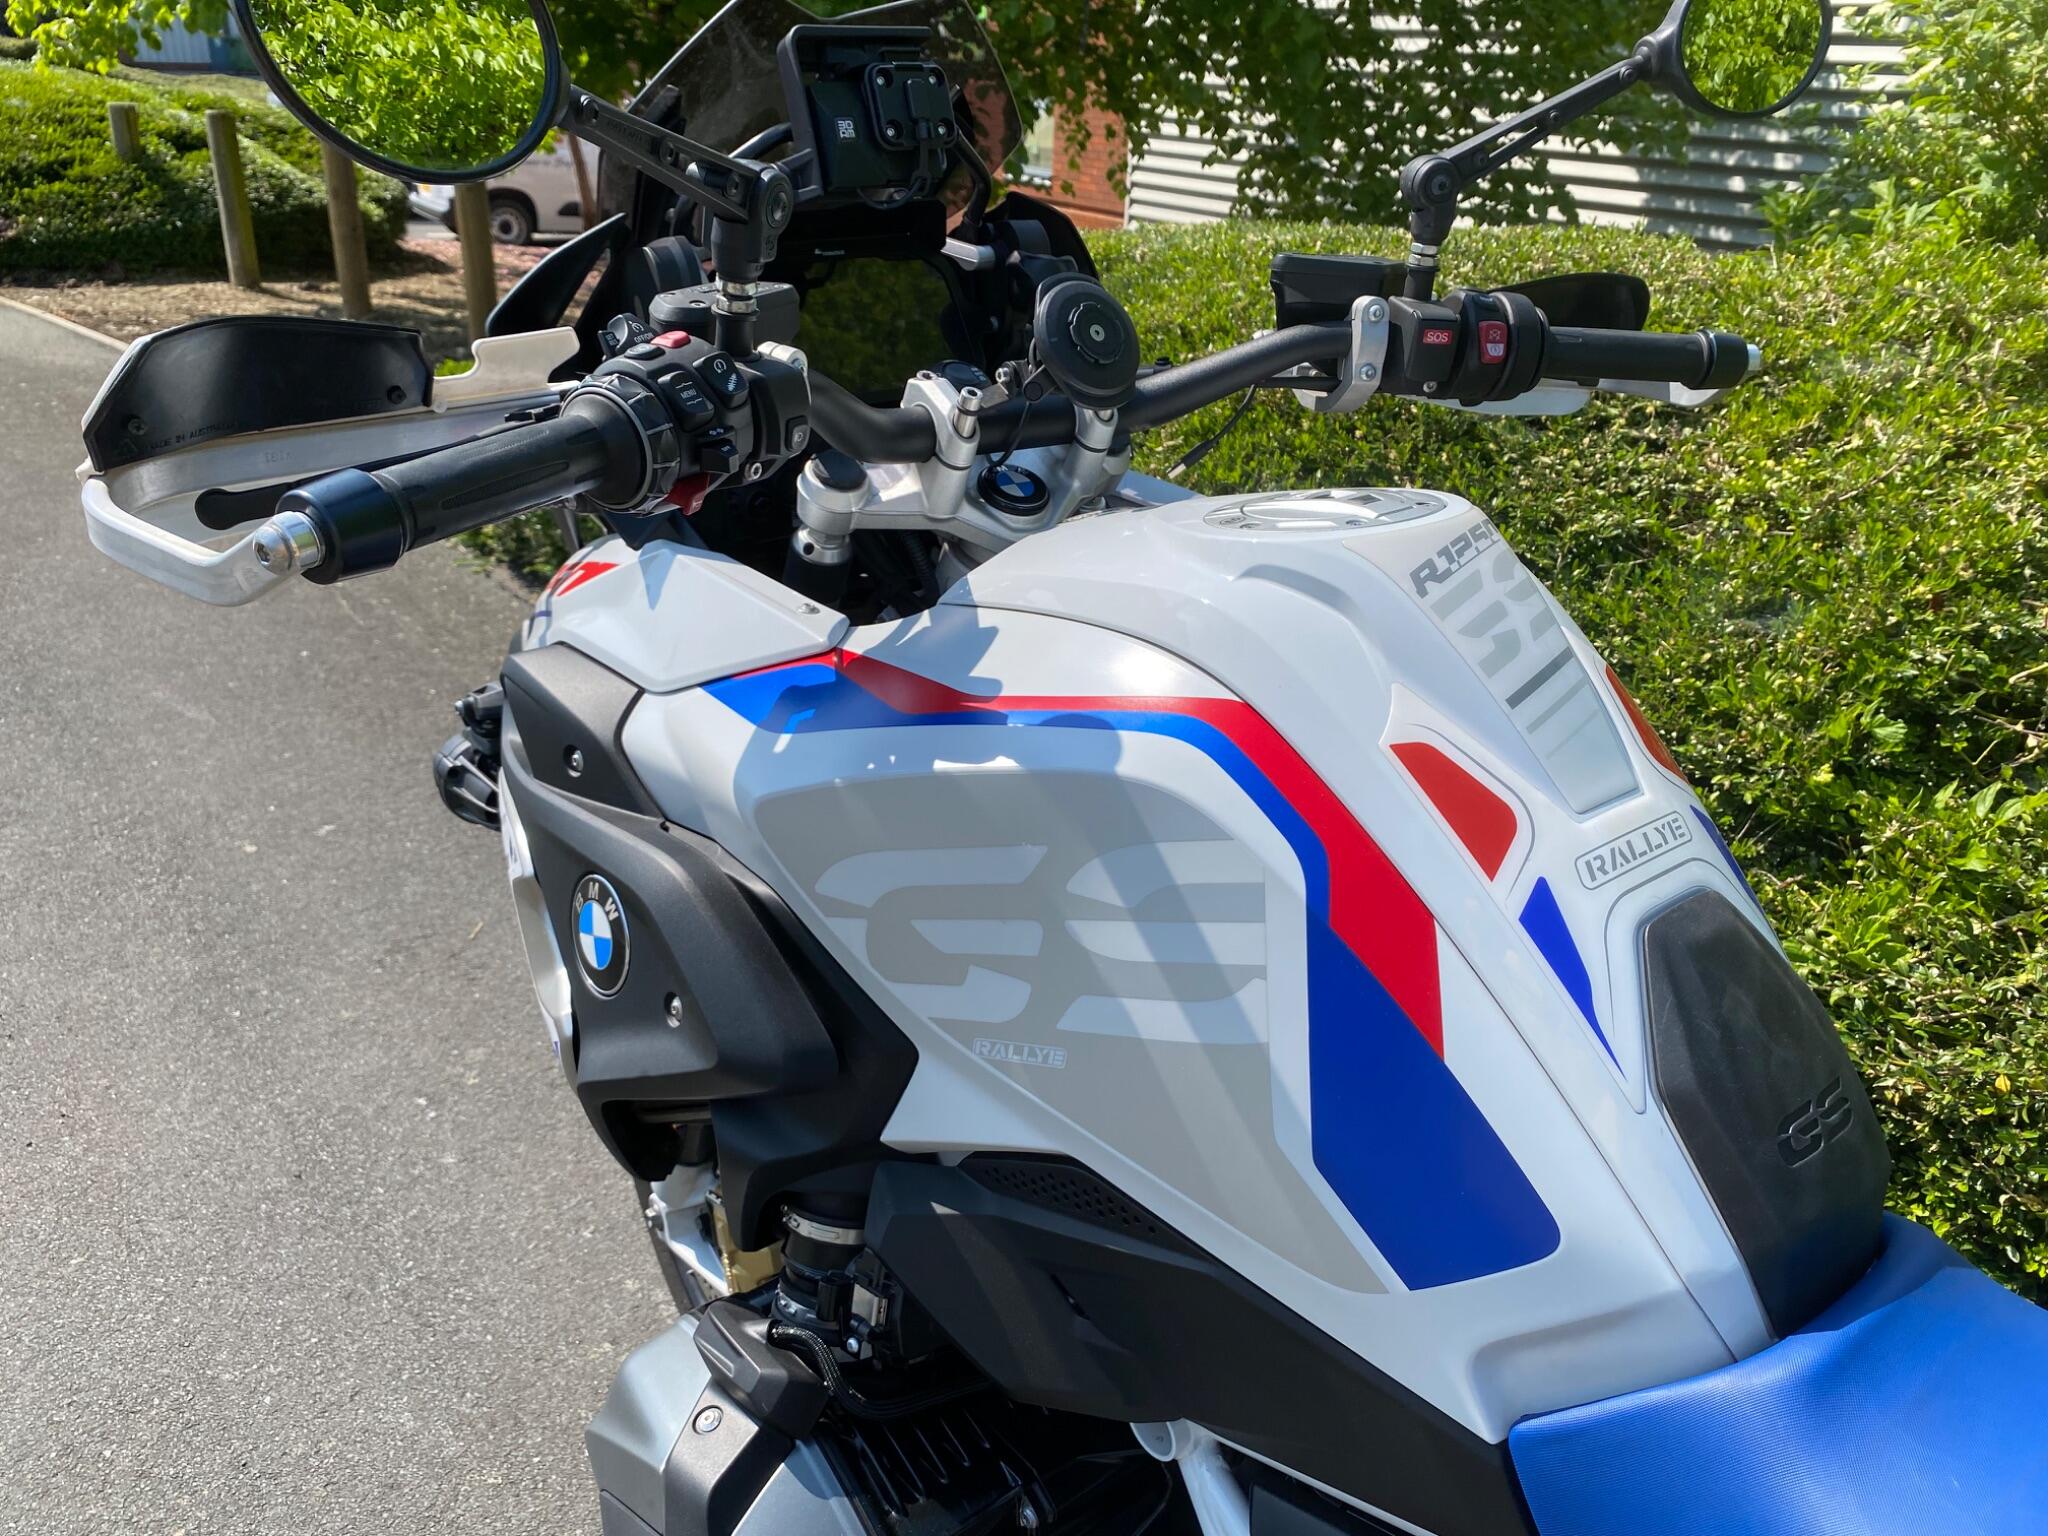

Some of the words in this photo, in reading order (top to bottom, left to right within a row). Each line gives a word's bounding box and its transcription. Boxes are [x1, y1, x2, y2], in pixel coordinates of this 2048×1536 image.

[1427, 331, 1449, 343] SOS
[680, 389, 697, 399] MENU
[1585, 817, 1686, 882] RALLYE
[575, 881, 620, 920] BMW
[975, 1041, 1064, 1064] RALLYE
[1777, 1076, 1853, 1168] GS
